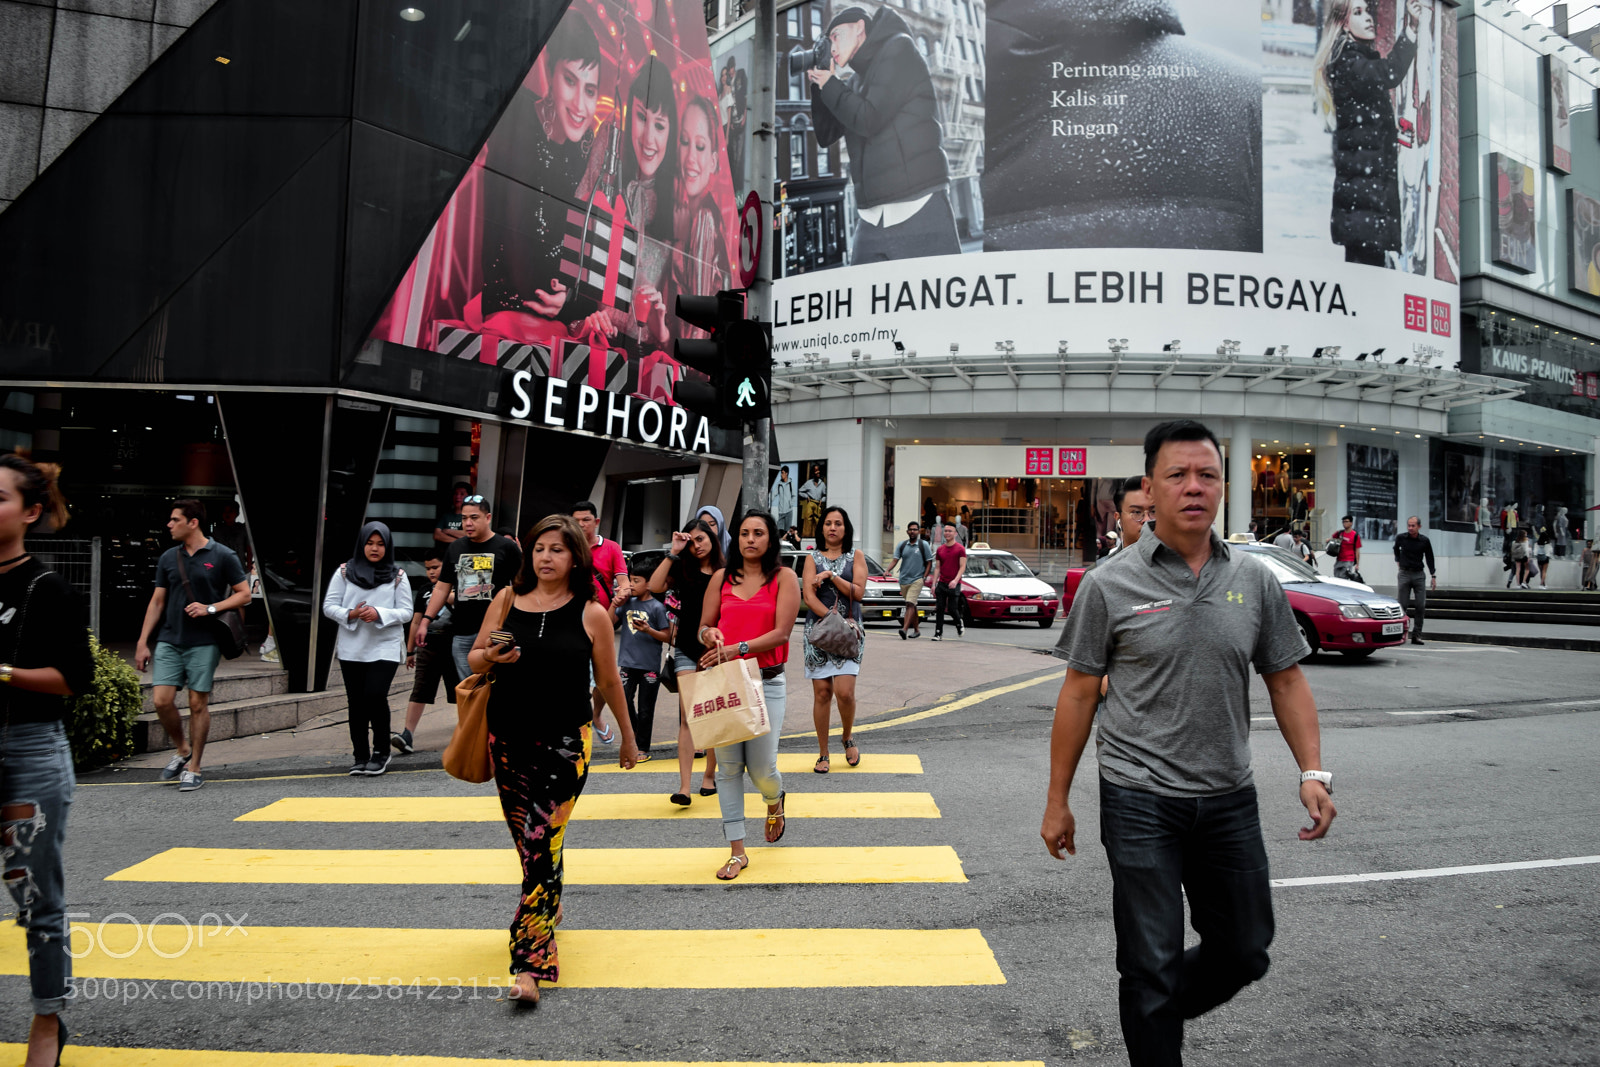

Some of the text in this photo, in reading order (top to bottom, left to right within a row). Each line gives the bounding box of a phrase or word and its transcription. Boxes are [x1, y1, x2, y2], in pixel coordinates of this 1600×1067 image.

[1051, 62, 1199, 80] Perintang angin
[1051, 89, 1128, 108] Kalis air
[1051, 119, 1119, 139] Ringan
[774, 271, 1357, 328] LEBIH HANGAT. LEBIH BERGAYA.
[1434, 304, 1448, 317] UNI
[1434, 319, 1449, 333] QLO
[772, 327, 899, 353] www.uniqlo.com/my
[1412, 342, 1444, 358] LifeWear
[1492, 347, 1577, 386] KAWS PEANUTS
[510, 370, 711, 453] SEPHORA
[1061, 450, 1082, 461] UNI
[1061, 461, 1084, 474] QLO
[692, 692, 742, 719] 無印良品
